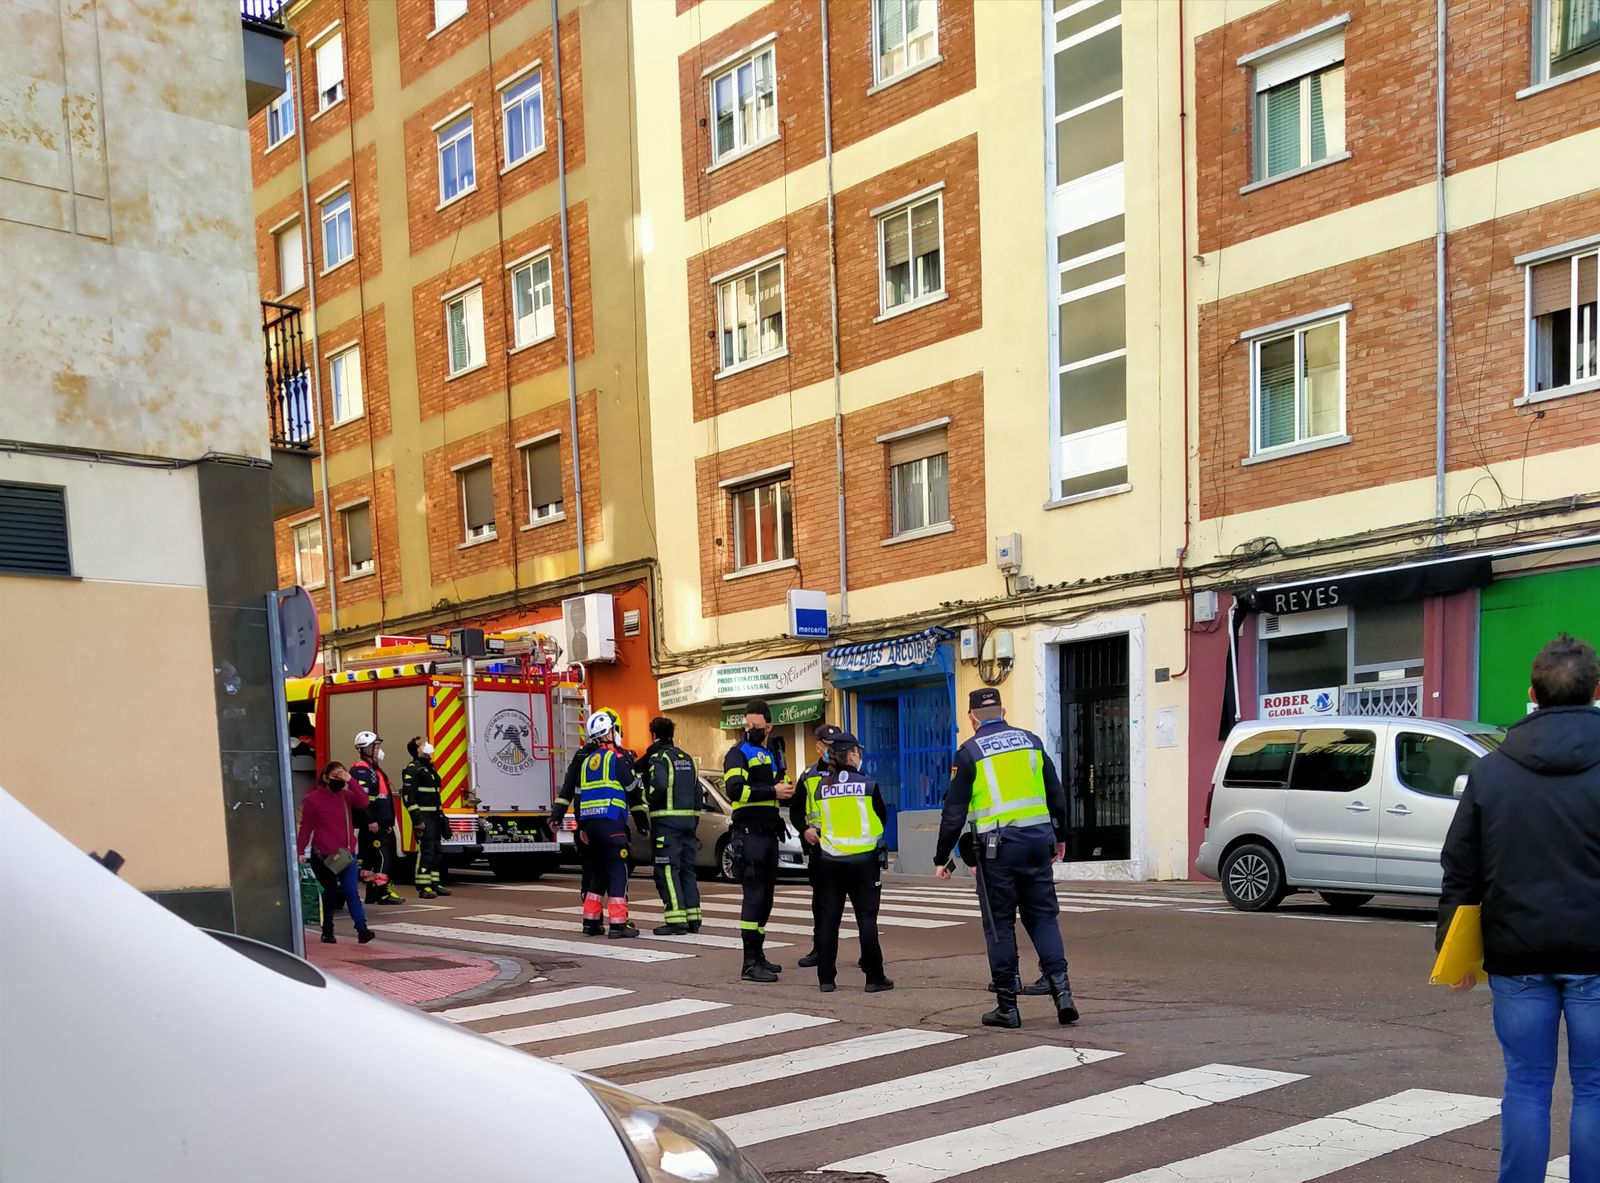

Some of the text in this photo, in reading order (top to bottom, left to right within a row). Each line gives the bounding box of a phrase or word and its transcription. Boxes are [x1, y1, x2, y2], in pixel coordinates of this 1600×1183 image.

[1275, 586, 1339, 612] REYES
[887, 640, 932, 663] ARCOIRIS
[776, 659, 818, 690] Marina
[1263, 694, 1310, 709] ROBER
[1268, 707, 1305, 718] GLOBAL
[981, 736, 1032, 754] POLICIA
[491, 755, 534, 774] BOMBEROS
[823, 784, 863, 797] POLICIA
